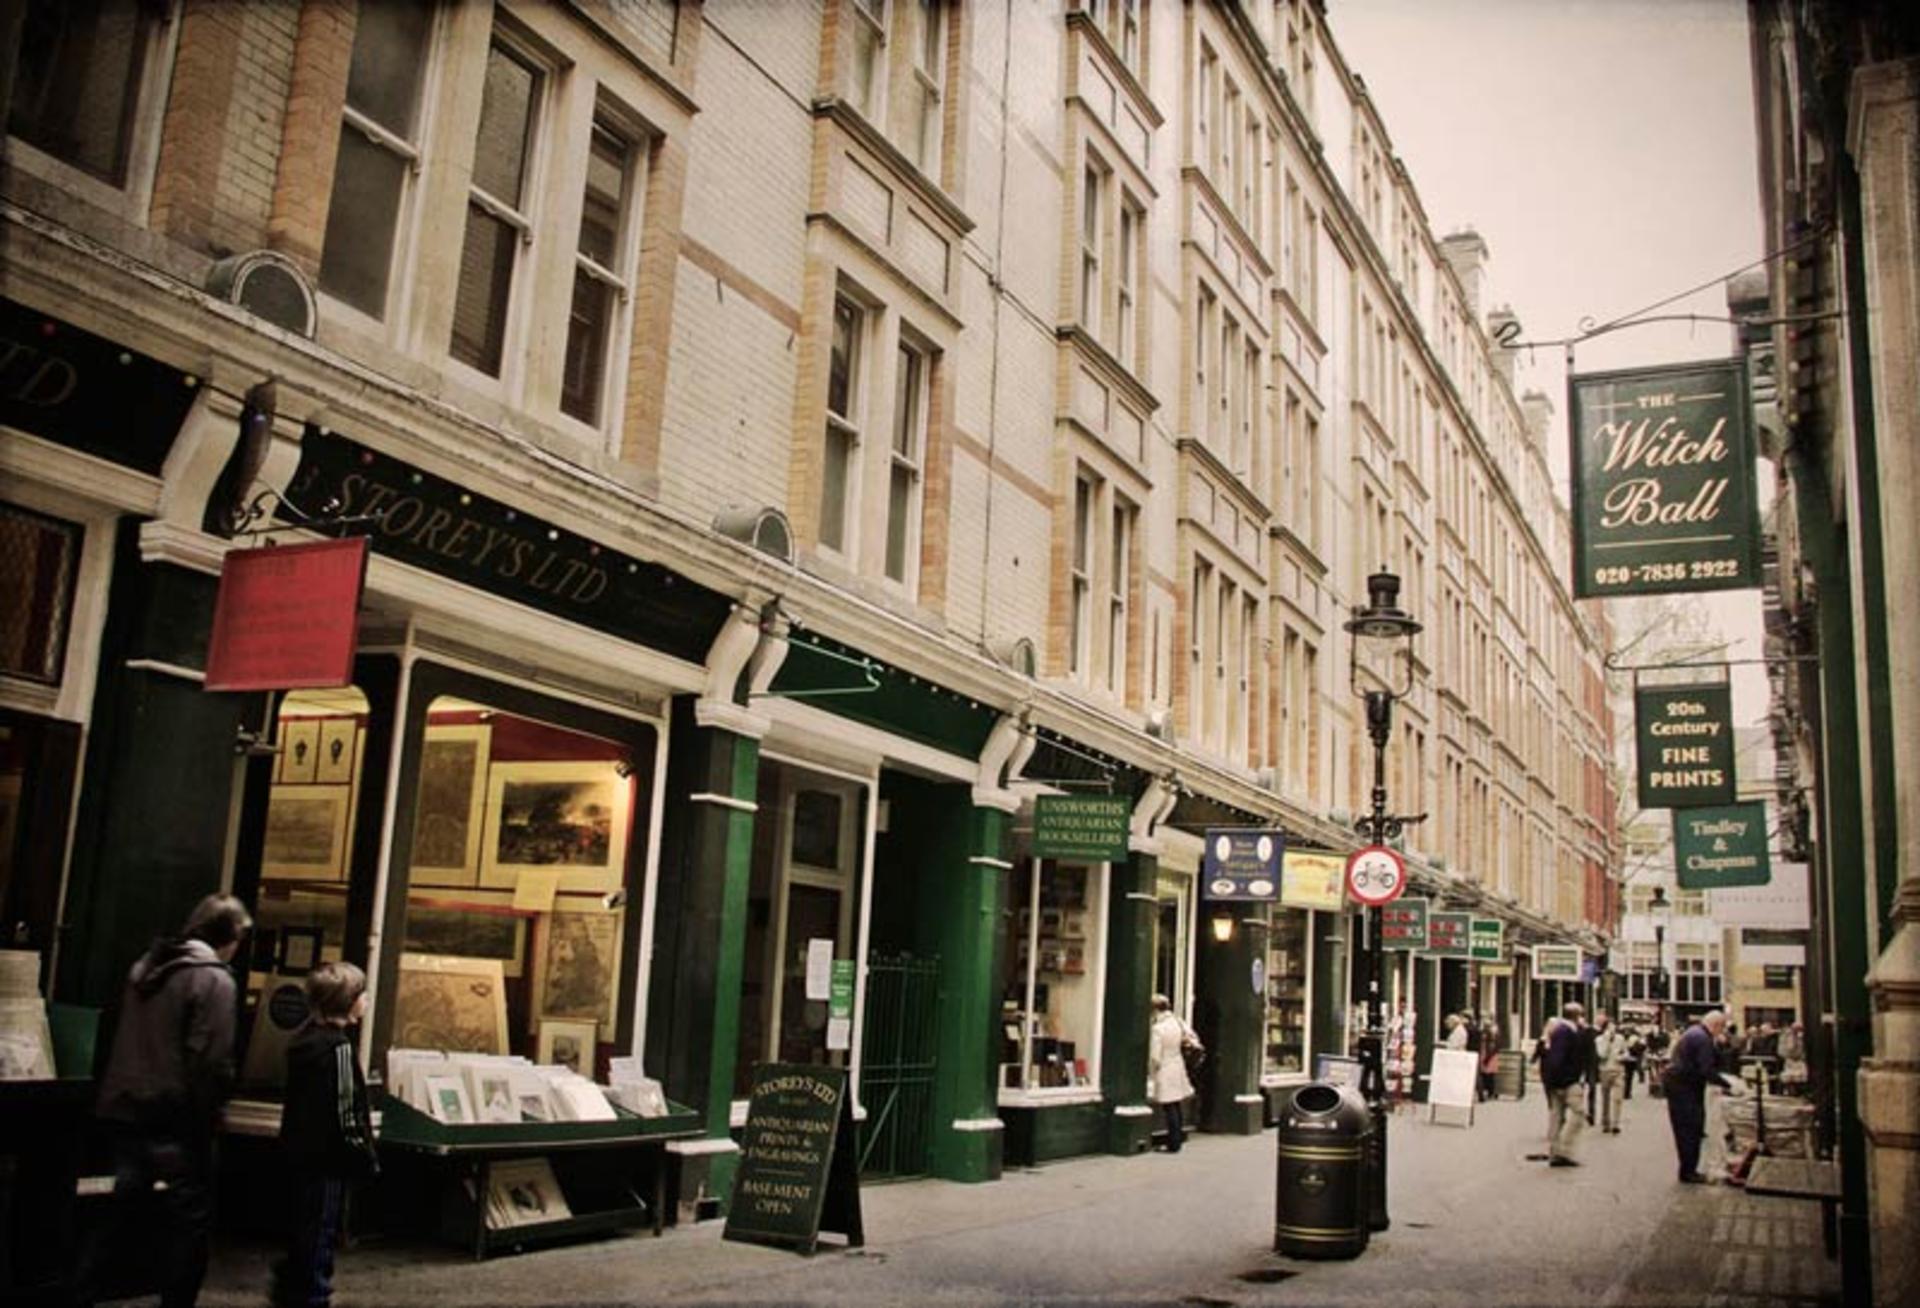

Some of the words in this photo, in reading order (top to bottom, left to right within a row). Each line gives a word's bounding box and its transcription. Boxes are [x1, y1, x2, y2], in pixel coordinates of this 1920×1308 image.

[1638, 393, 1675, 408] THE
[1593, 416, 1729, 472] Witch
[1601, 477, 1729, 529] Ball
[338, 473, 535, 578] STOREY'S
[519, 551, 609, 603] LTD
[1595, 563, 1687, 585] 020-7836
[1690, 560, 1739, 579] 2922
[1666, 702, 1706, 717] 20th
[1650, 720, 1721, 737] Century
[1662, 746, 1711, 765] FINE
[1650, 770, 1724, 789] PRINTS
[1040, 815, 1122, 830] ANTIQUARIAN
[1039, 830, 1122, 846] BOOKSELLERS
[1712, 836, 1729, 852] &
[813, 1081, 837, 1104] LTD
[751, 1116, 831, 1134] ANTIQUARIAN
[759, 1132, 799, 1146] PRINTS
[748, 1147, 820, 1163] ENGRAVINGS
[743, 1181, 812, 1199] BASEMENT
[755, 1200, 793, 1215] OPEN
